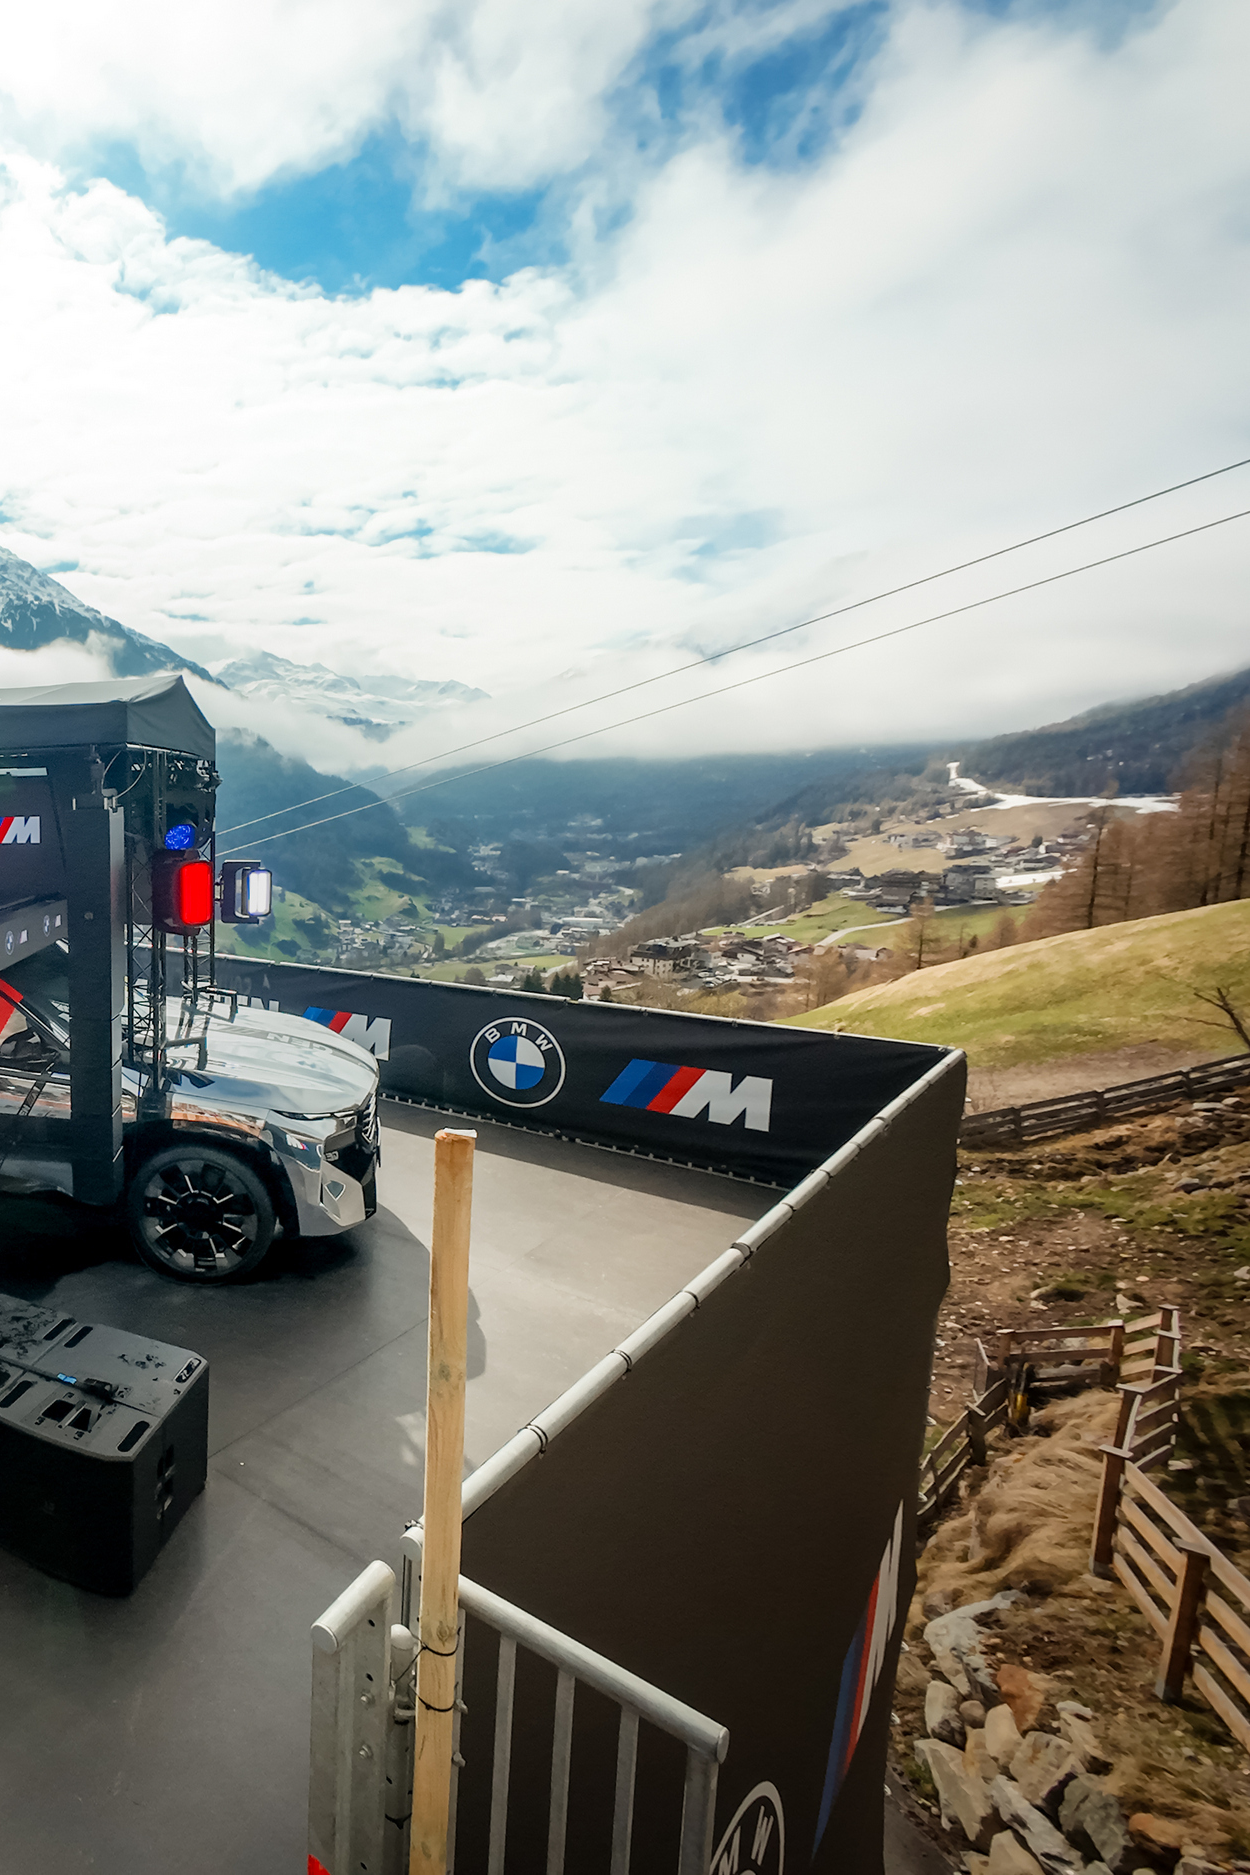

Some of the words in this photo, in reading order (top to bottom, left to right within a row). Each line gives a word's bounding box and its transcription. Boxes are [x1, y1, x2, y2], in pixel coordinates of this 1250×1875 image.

[2, 816, 40, 844] M
[484, 1022, 553, 1052] BMW
[669, 1069, 773, 1132] M
